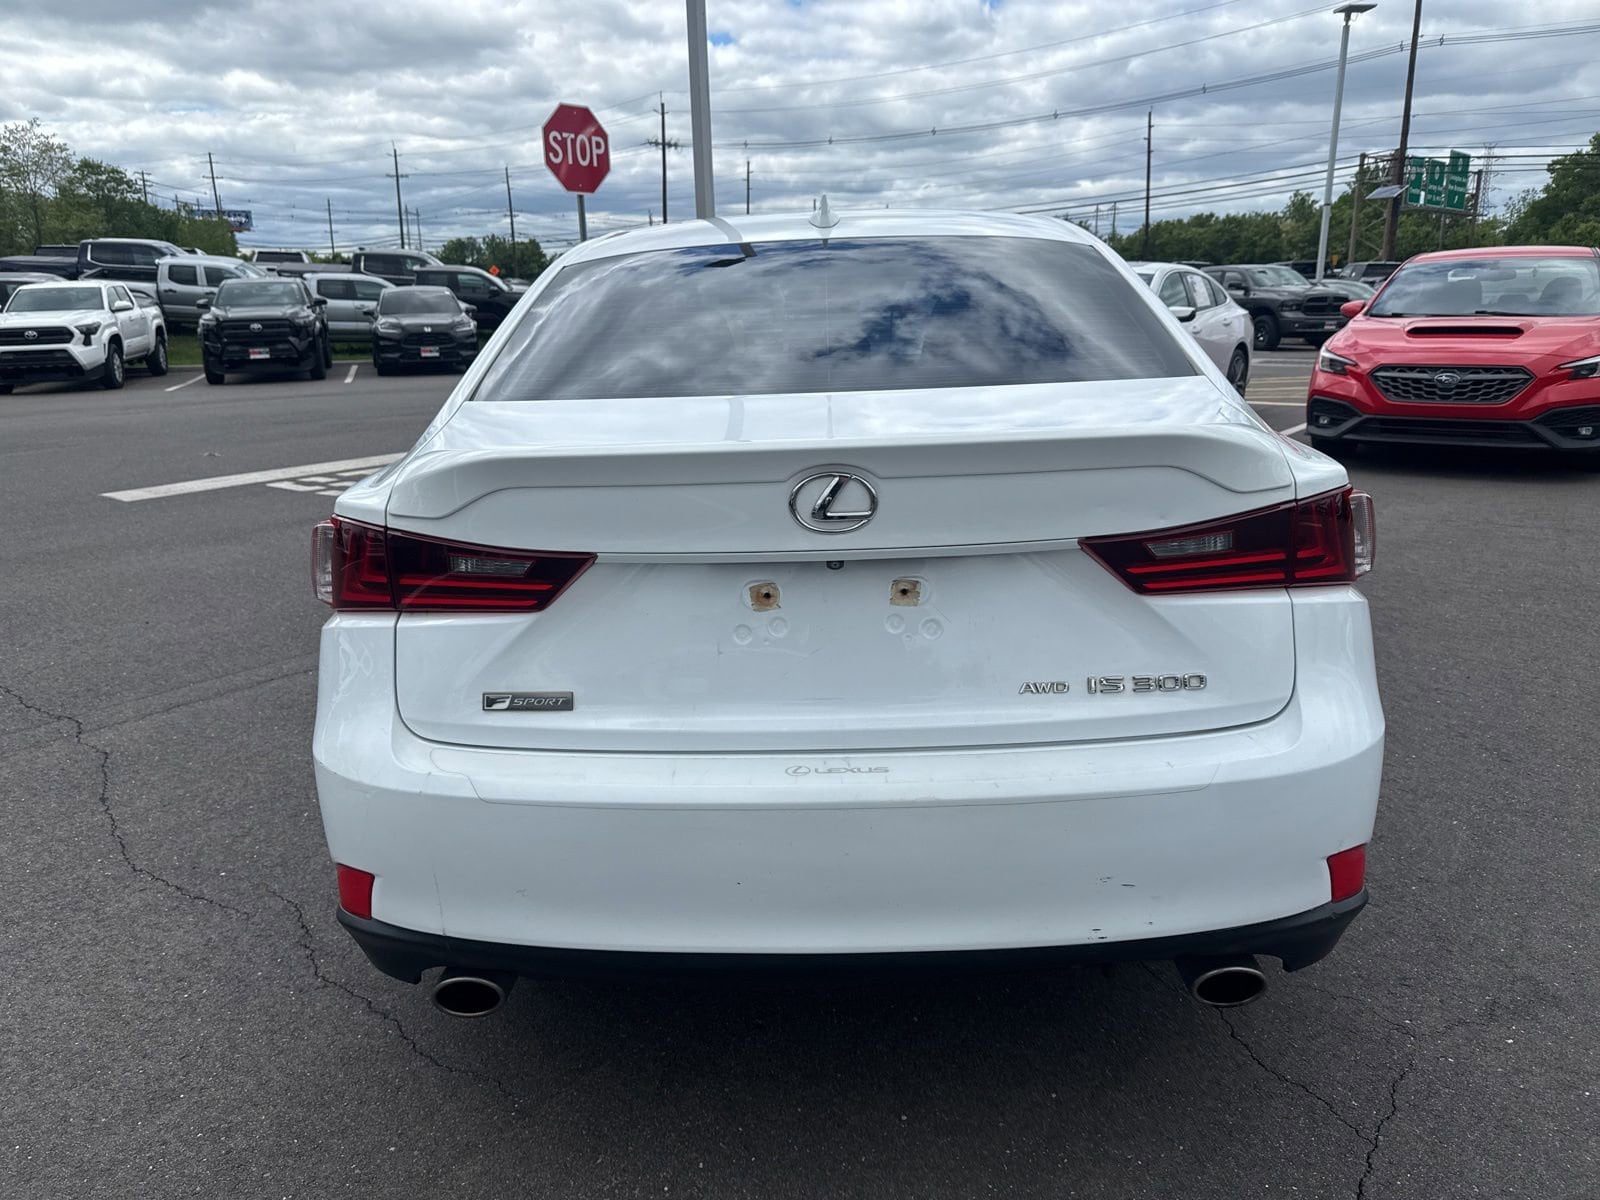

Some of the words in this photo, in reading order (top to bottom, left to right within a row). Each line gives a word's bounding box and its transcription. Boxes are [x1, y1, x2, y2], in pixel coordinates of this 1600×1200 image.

[548, 130, 606, 168] STOP
[1018, 681, 1070, 695] AWD
[1087, 675, 1126, 695] IS
[1131, 673, 1208, 694] 300
[513, 697, 567, 706] SPORT
[814, 766, 890, 774] LEXUS
